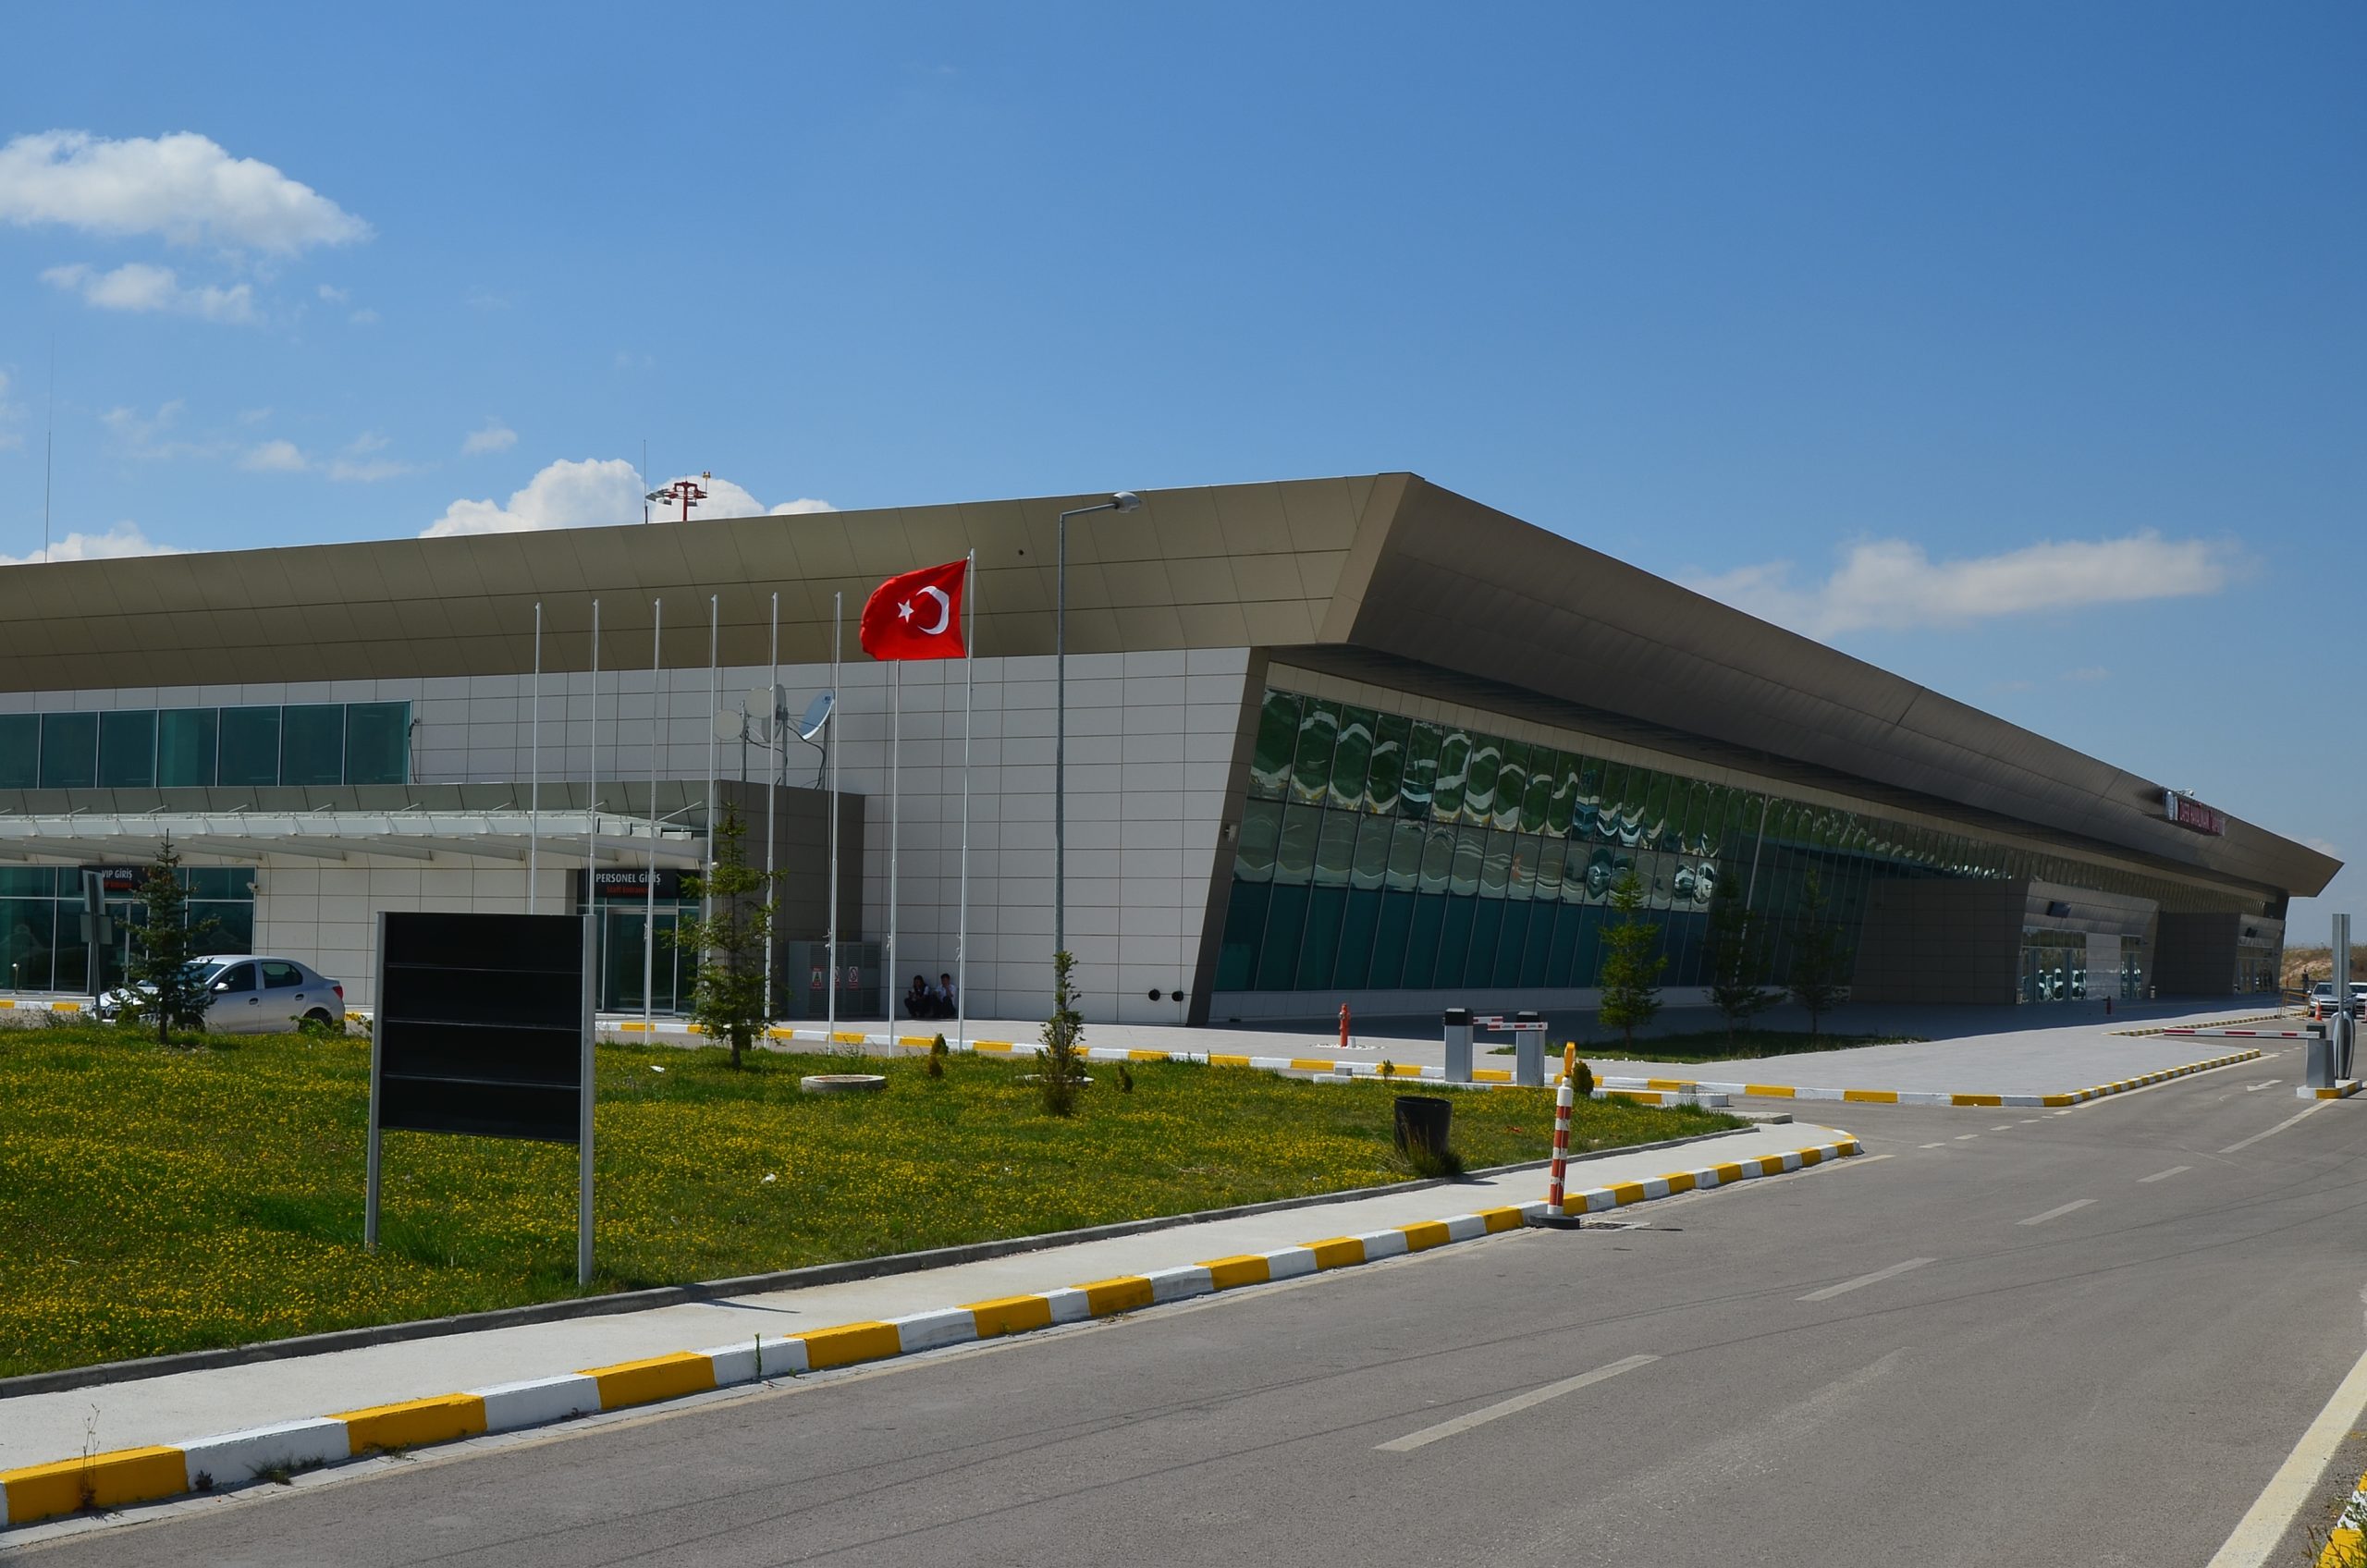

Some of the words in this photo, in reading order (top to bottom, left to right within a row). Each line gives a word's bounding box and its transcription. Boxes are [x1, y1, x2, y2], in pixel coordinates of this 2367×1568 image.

[102, 870, 113, 878] VIP
[115, 868, 132, 880] GİRİŞ
[595, 873, 636, 883] PERSONEL
[639, 871, 661, 885] GİİŞ
